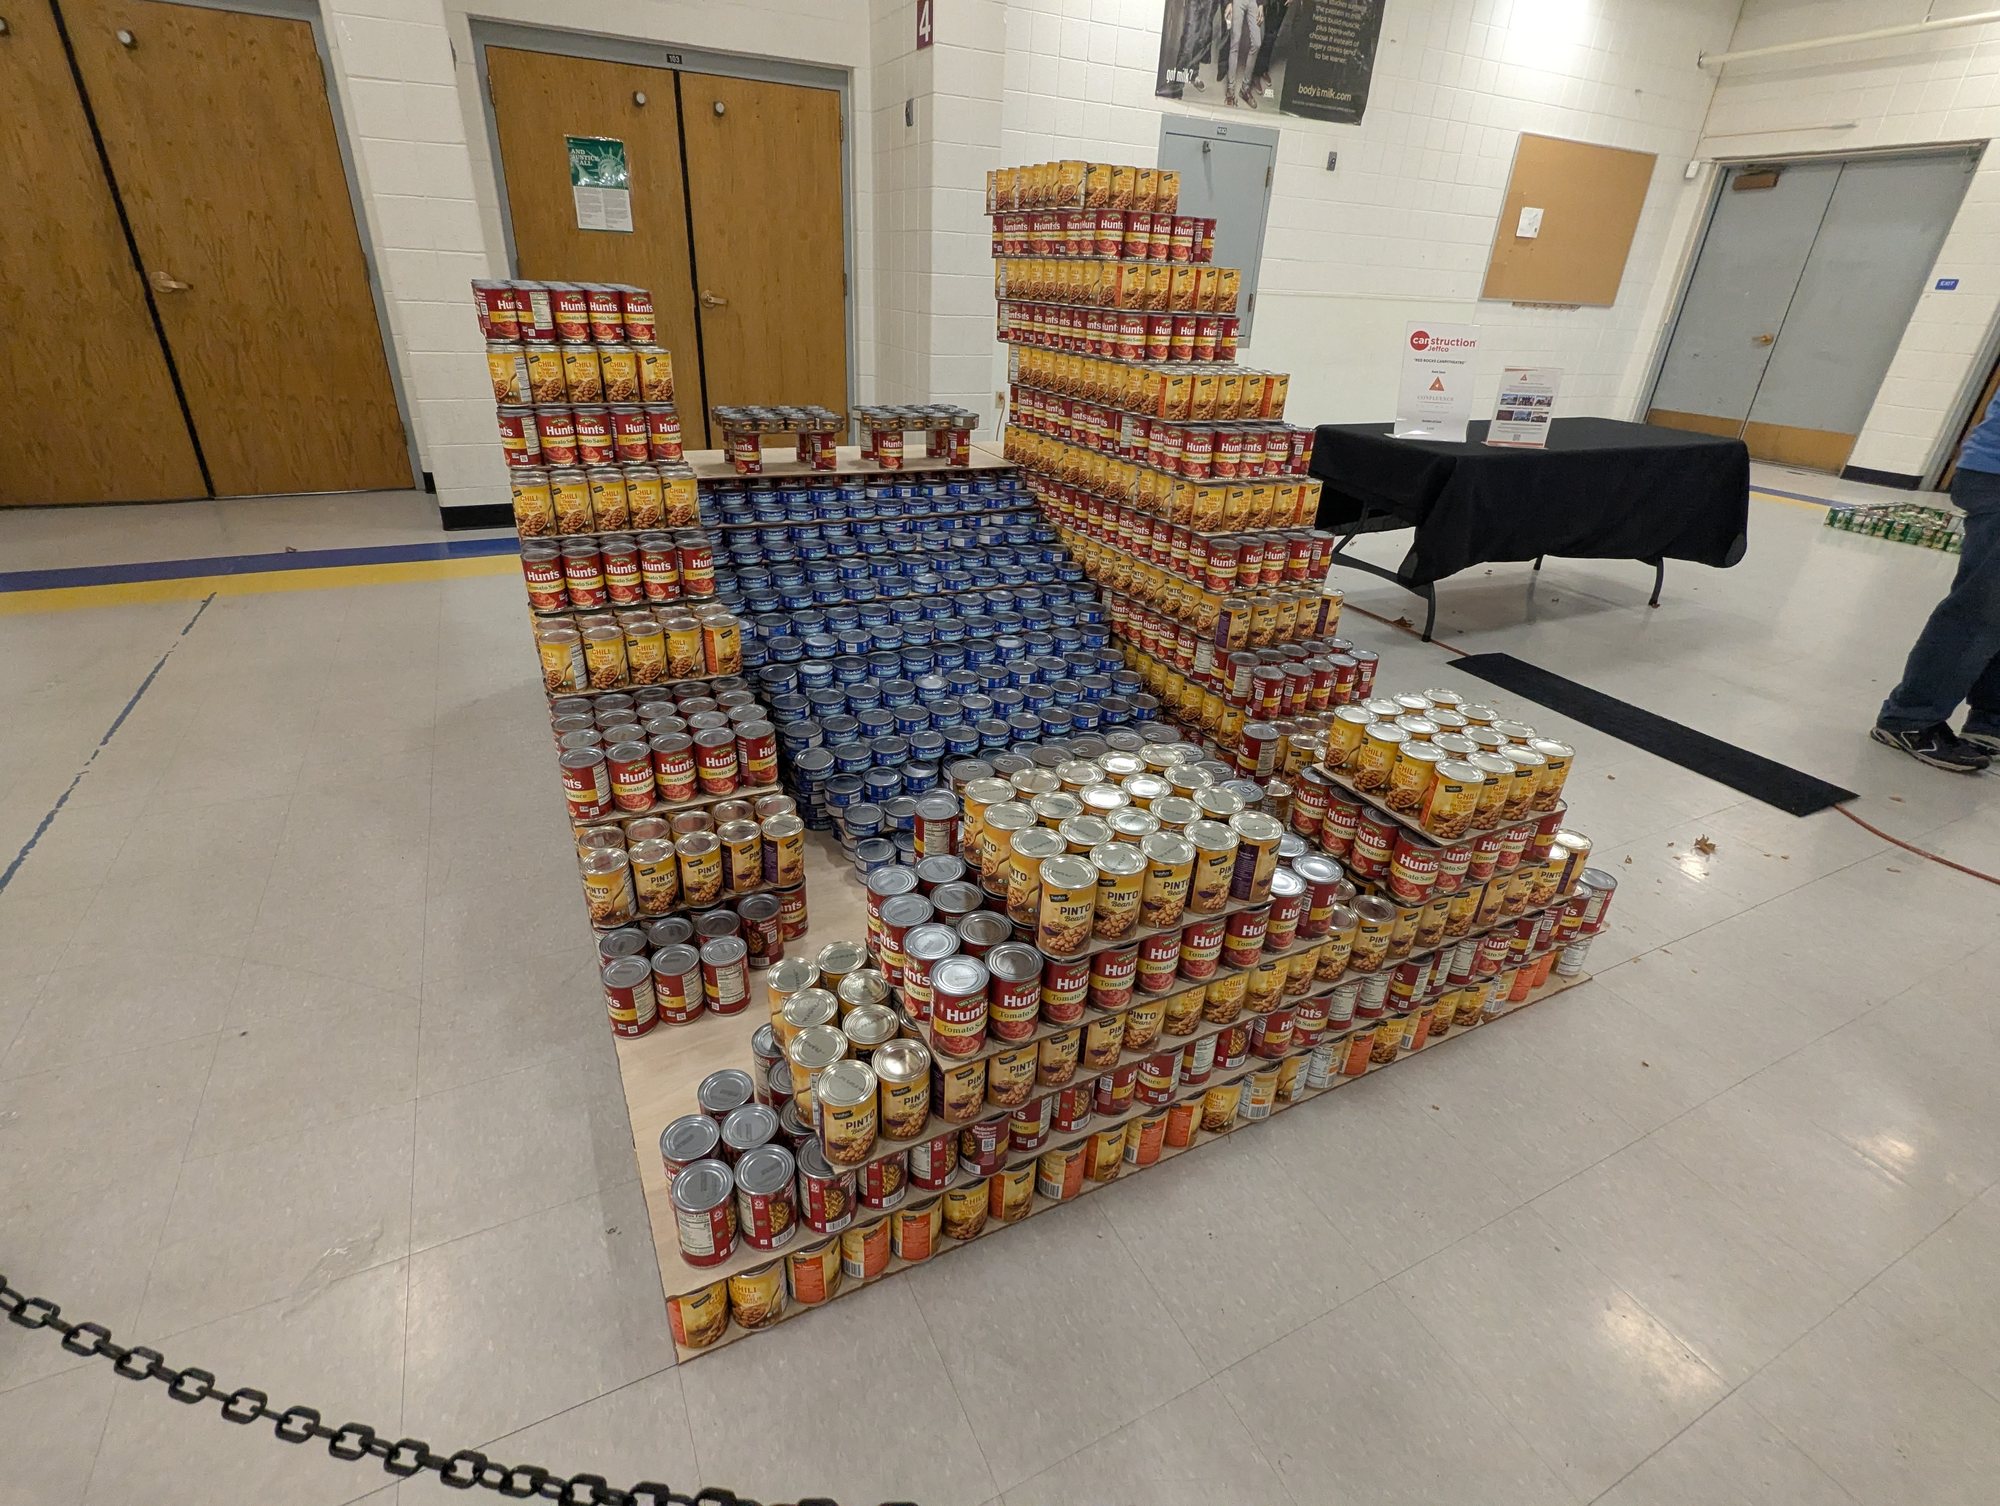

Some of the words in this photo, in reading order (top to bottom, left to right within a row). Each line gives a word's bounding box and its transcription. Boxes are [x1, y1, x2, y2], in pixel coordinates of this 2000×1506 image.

[919, 0, 931, 42] 4
[1167, 68, 1176, 83] got
[1176, 68, 1193, 83] milk?
[498, 300, 515, 309] Hun
[1155, 326, 1171, 335] Hun
[1181, 326, 1195, 335] Hun
[626, 424, 645, 433] Hun
[659, 424, 680, 433] Hun
[692, 559, 712, 568] Hun
[670, 639, 686, 647] CHILI
[1364, 745, 1383, 757] CHILI
[705, 769, 724, 778] Tomato
[1398, 764, 1418, 776] CHILI
[660, 775, 679, 784] Tomato
[619, 784, 643, 793] Tomato
[1367, 847, 1387, 858] Sauce
[698, 863, 720, 875] PINTO
[1394, 866, 1419, 882] Tomato
[650, 872, 675, 884] PINTO
[1108, 890, 1138, 901] PINTO
[1111, 899, 1134, 908] Beans
[1060, 905, 1090, 915] PINTO
[1064, 913, 1087, 923] Beans
[1243, 920, 1266, 936] Hun
[1236, 937, 1264, 947] Tomato
[1369, 935, 1388, 943] PINT
[1331, 943, 1351, 953] PINT
[1188, 949, 1214, 958] Tomato
[1145, 961, 1172, 971] Tomato
[1100, 977, 1125, 987] Tomato
[1051, 992, 1077, 1001] Tomato
[999, 1007, 1029, 1018] Tomato
[1128, 1010, 1156, 1020] PINTO
[942, 1022, 973, 1035] Tomato
[968, 1070, 985, 1087] PINT
[904, 1085, 930, 1106] PINTO
[845, 1110, 876, 1130] PINTO
